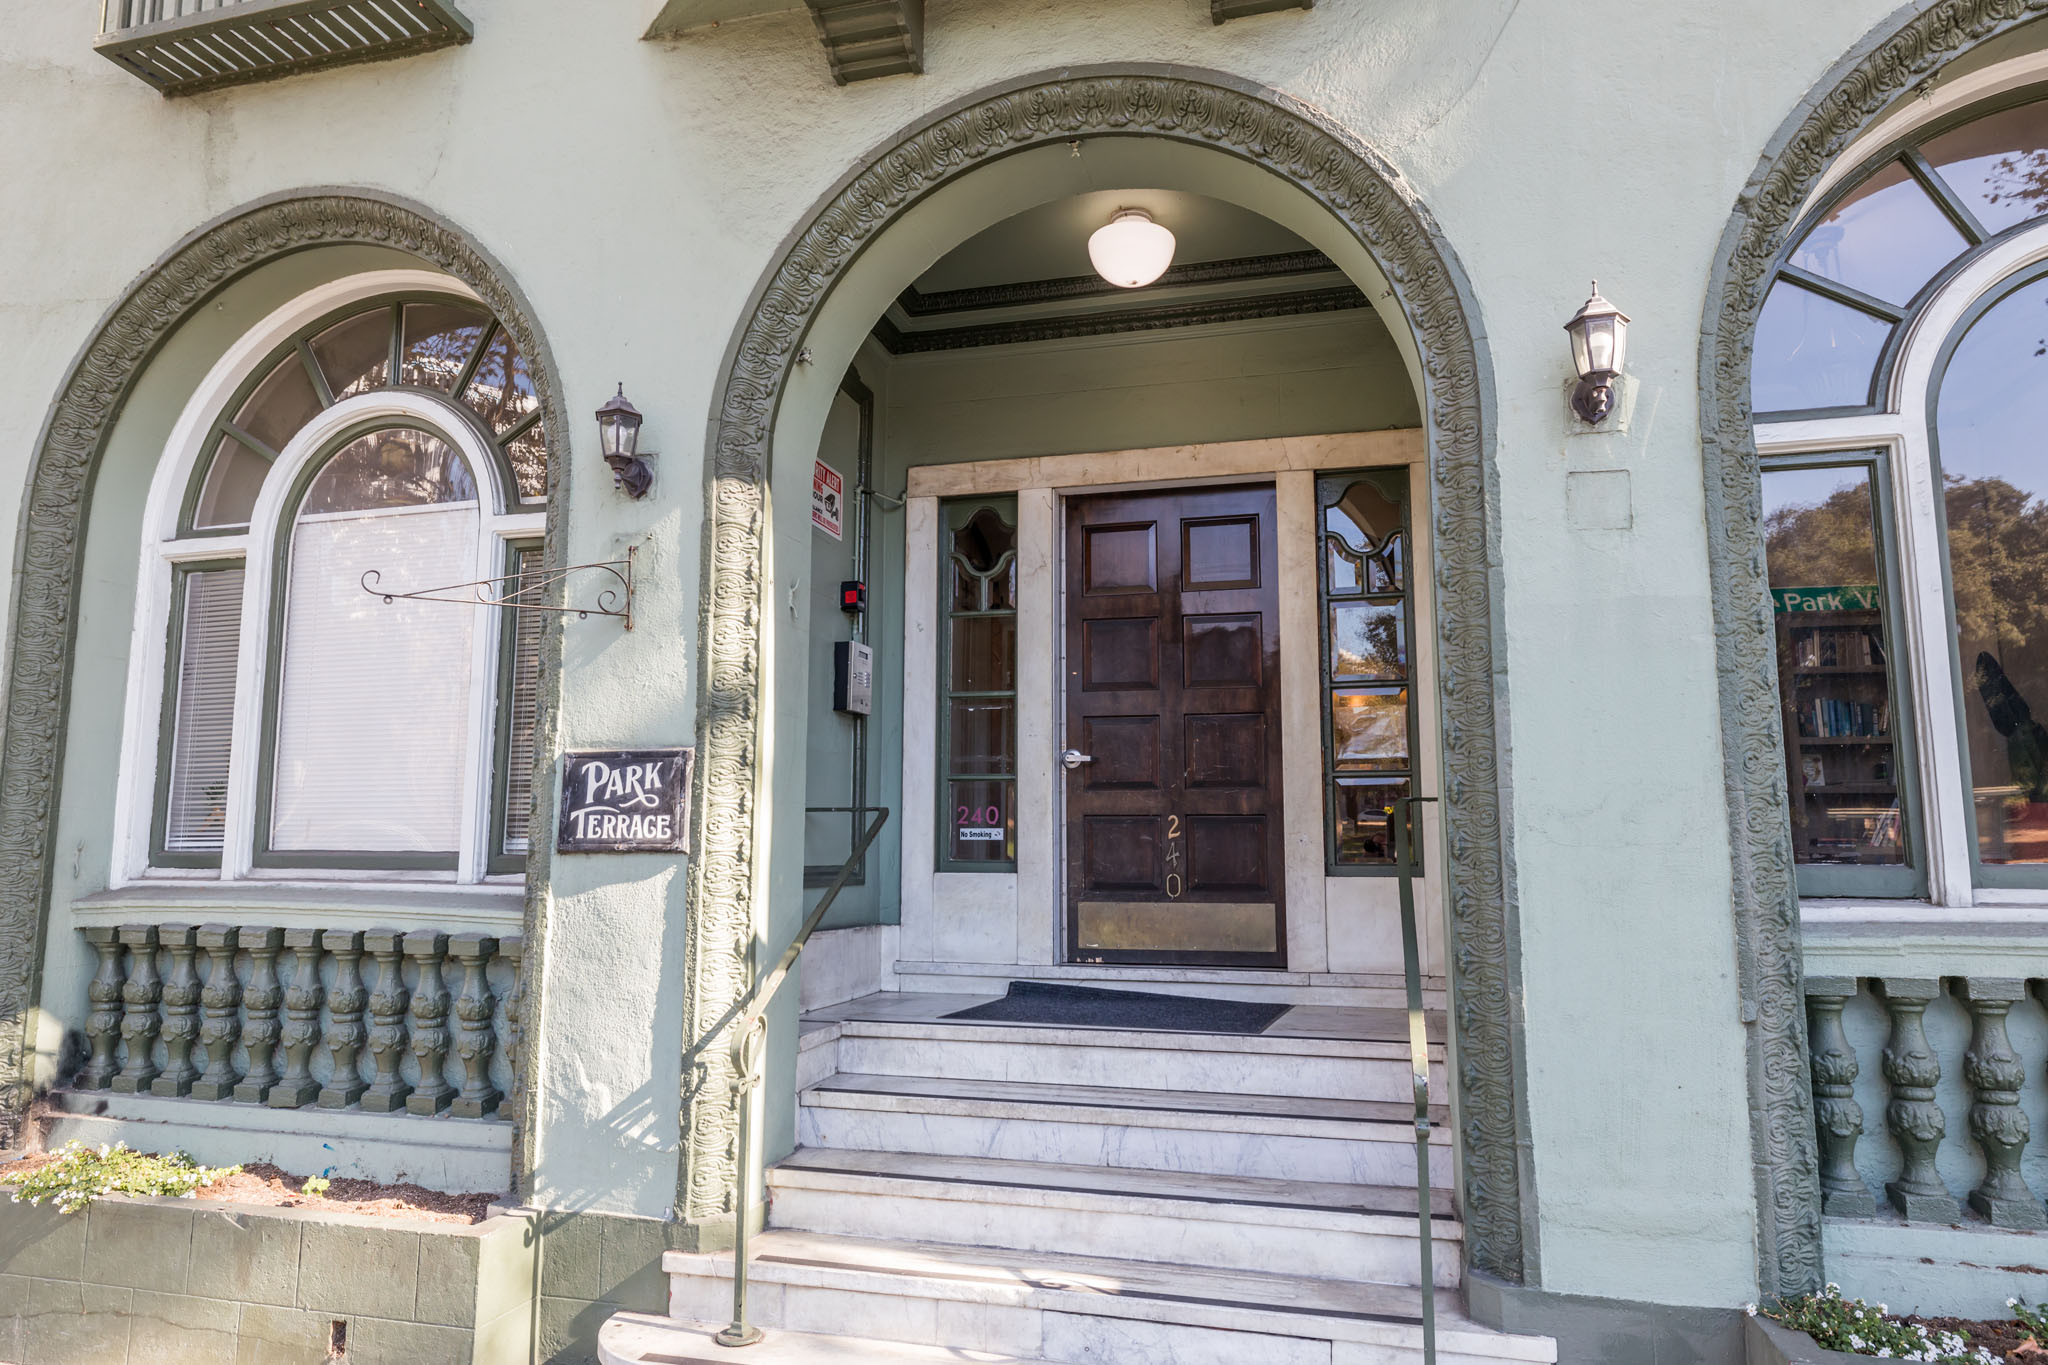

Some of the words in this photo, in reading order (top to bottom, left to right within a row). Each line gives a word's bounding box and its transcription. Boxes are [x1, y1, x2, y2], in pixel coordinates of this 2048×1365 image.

[1783, 592, 1843, 612] Park
[581, 761, 664, 808] PARK
[570, 805, 672, 839] TERRACE
[957, 805, 999, 825] 240
[969, 830, 992, 839] Smoking
